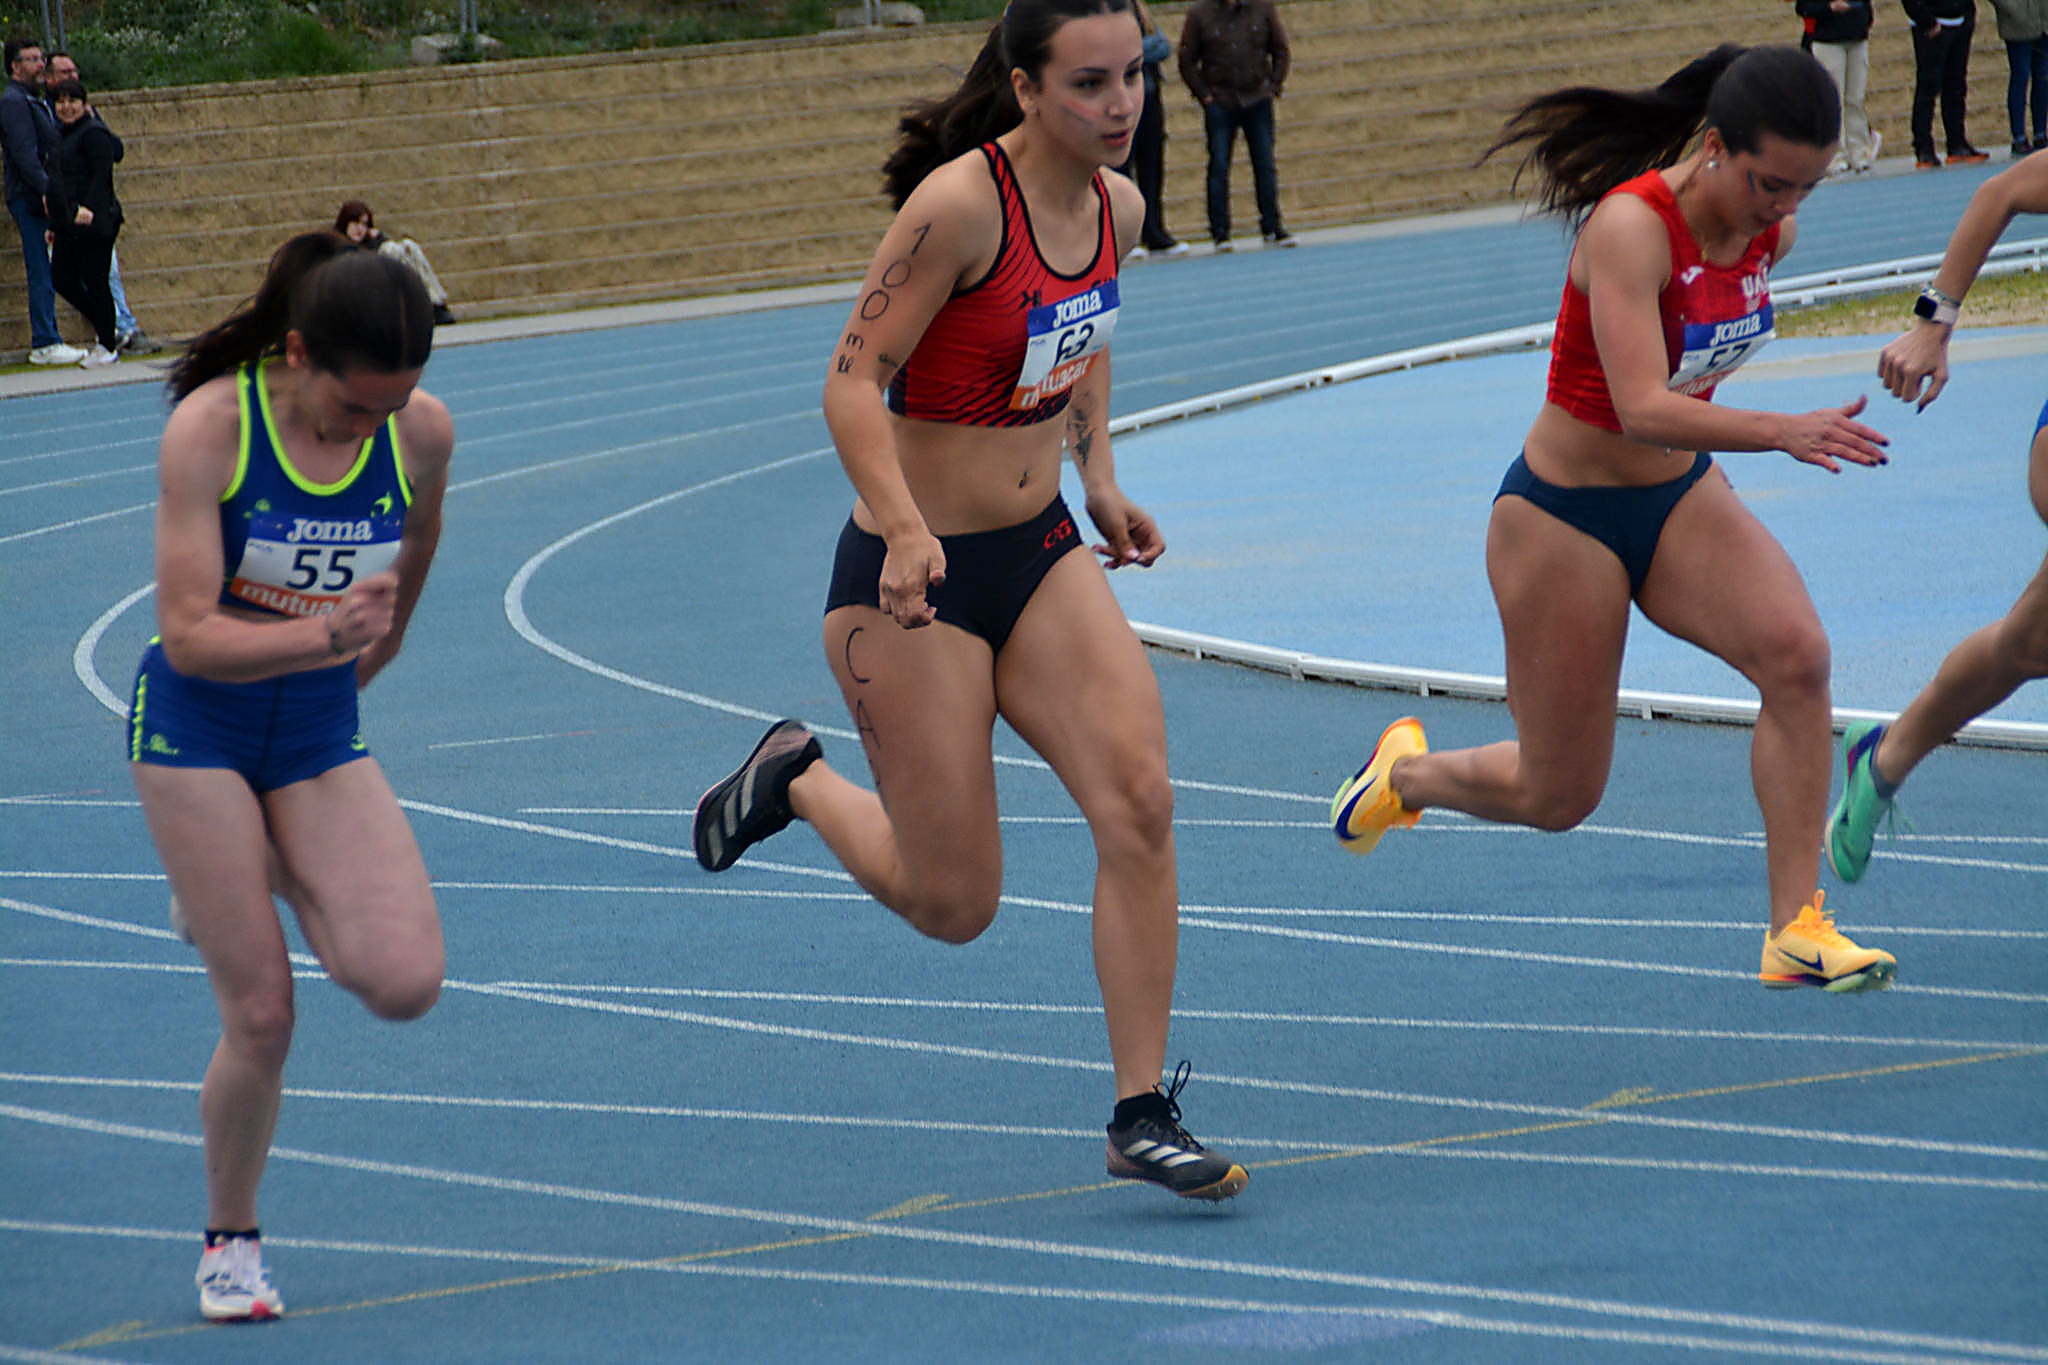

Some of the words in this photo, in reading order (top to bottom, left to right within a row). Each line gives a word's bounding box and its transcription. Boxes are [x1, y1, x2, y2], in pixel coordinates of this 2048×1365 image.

[861, 223, 932, 321] 100
[286, 518, 373, 542] Joma
[285, 548, 357, 592] 55
